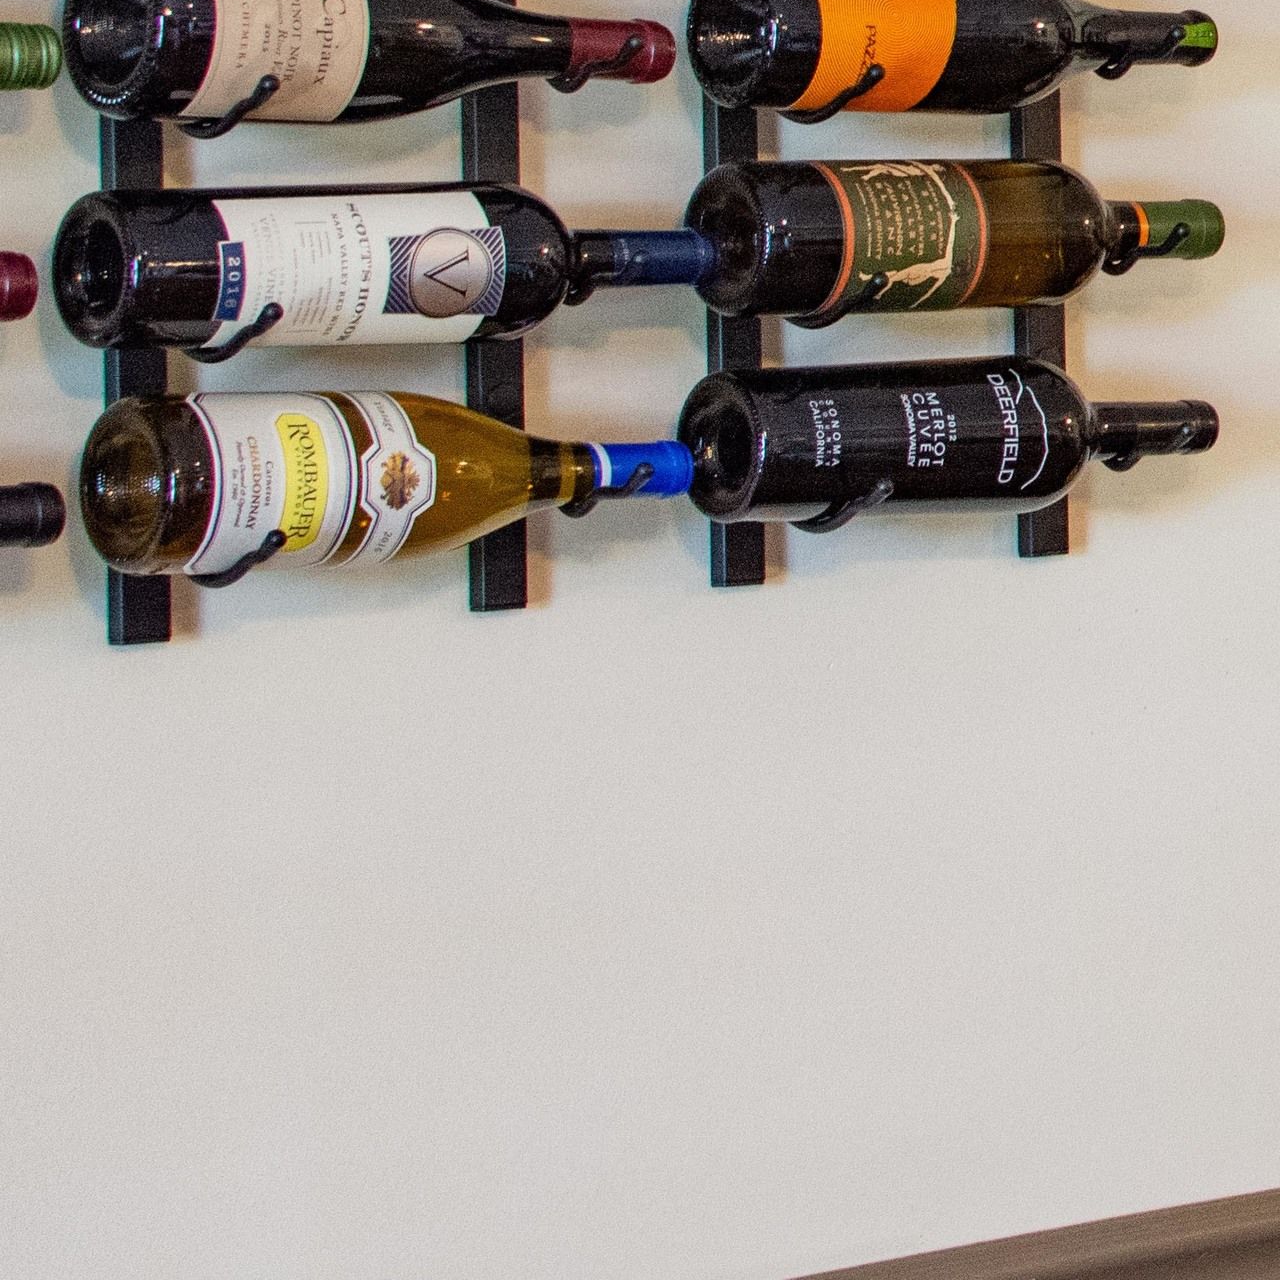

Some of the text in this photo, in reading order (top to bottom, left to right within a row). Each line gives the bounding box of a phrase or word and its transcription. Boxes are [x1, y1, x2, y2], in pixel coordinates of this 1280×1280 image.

[236, 2, 251, 69] CHIMERA
[284, 46, 300, 82] NOIR
[897, 182, 917, 253] VALLEY
[321, 213, 349, 338] NAPA VALLEY RED WINE
[336, 202, 372, 342] SCOUT'S HONOR
[425, 246, 469, 299] V
[809, 400, 825, 468] CALIFORNIA
[825, 399, 842, 467] SONOMA
[900, 393, 917, 467] SONOMA VALLEY
[912, 392, 932, 468] CUVÉE
[924, 392, 946, 467] MERLOT
[945, 414, 957, 442] 2012
[986, 373, 1020, 484] DEERFIELD
[245, 436, 263, 530] CHARDONNAY
[264, 460, 275, 507] Carneros
[287, 423, 319, 539] ROMBAUER
